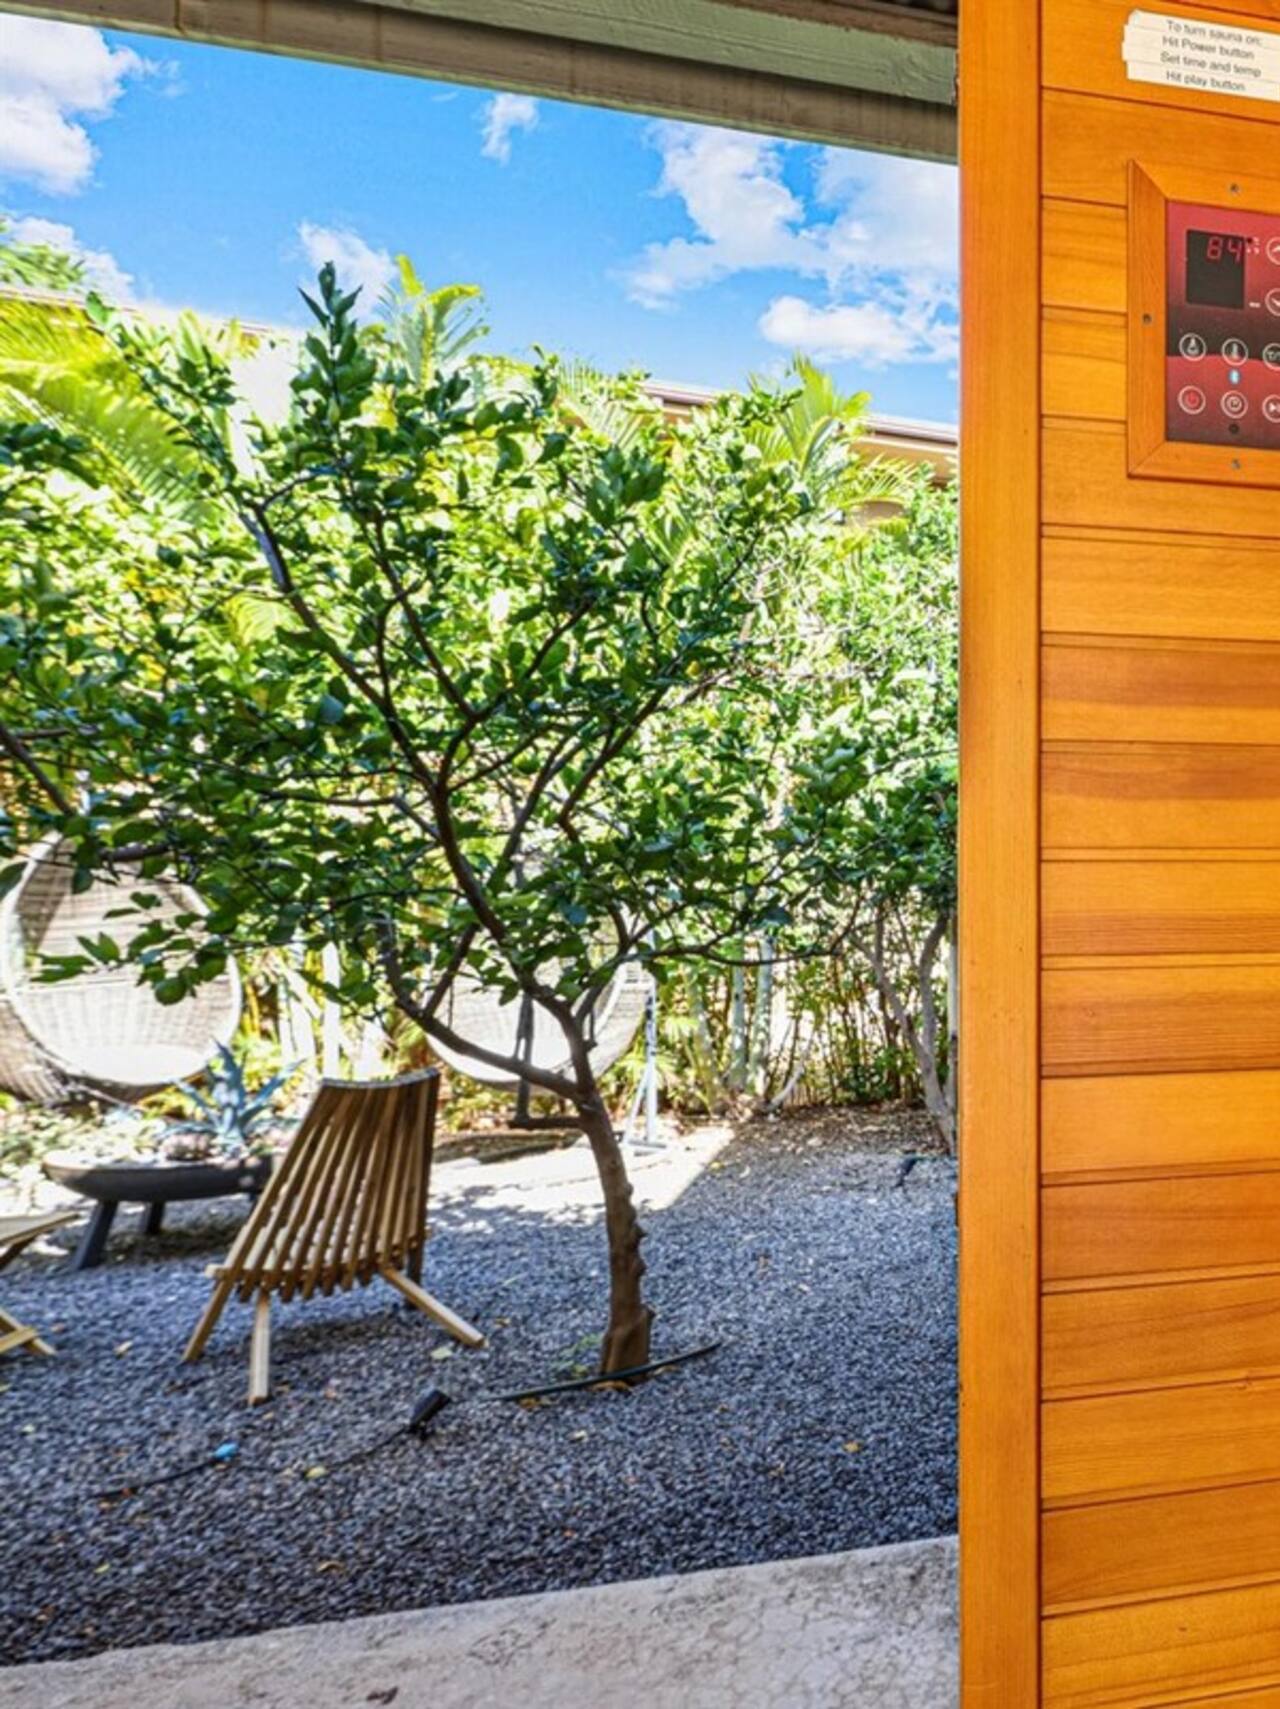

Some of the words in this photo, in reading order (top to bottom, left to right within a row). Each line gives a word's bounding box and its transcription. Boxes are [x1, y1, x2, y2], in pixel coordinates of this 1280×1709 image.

[1166, 19, 1182, 32] To
[1184, 25, 1206, 36] turn
[1209, 29, 1243, 44] sauna
[1162, 36, 1179, 48] Hit
[1181, 38, 1217, 53] Power
[1219, 45, 1255, 60] button
[1160, 51, 1180, 63] Set
[1183, 56, 1206, 69] time
[1210, 60, 1231, 73] and
[1234, 64, 1262, 78] temp
[1166, 71, 1182, 83] Hit
[1184, 74, 1208, 88] play
[1210, 77, 1246, 91] button
[1207, 236, 1243, 262] 84
